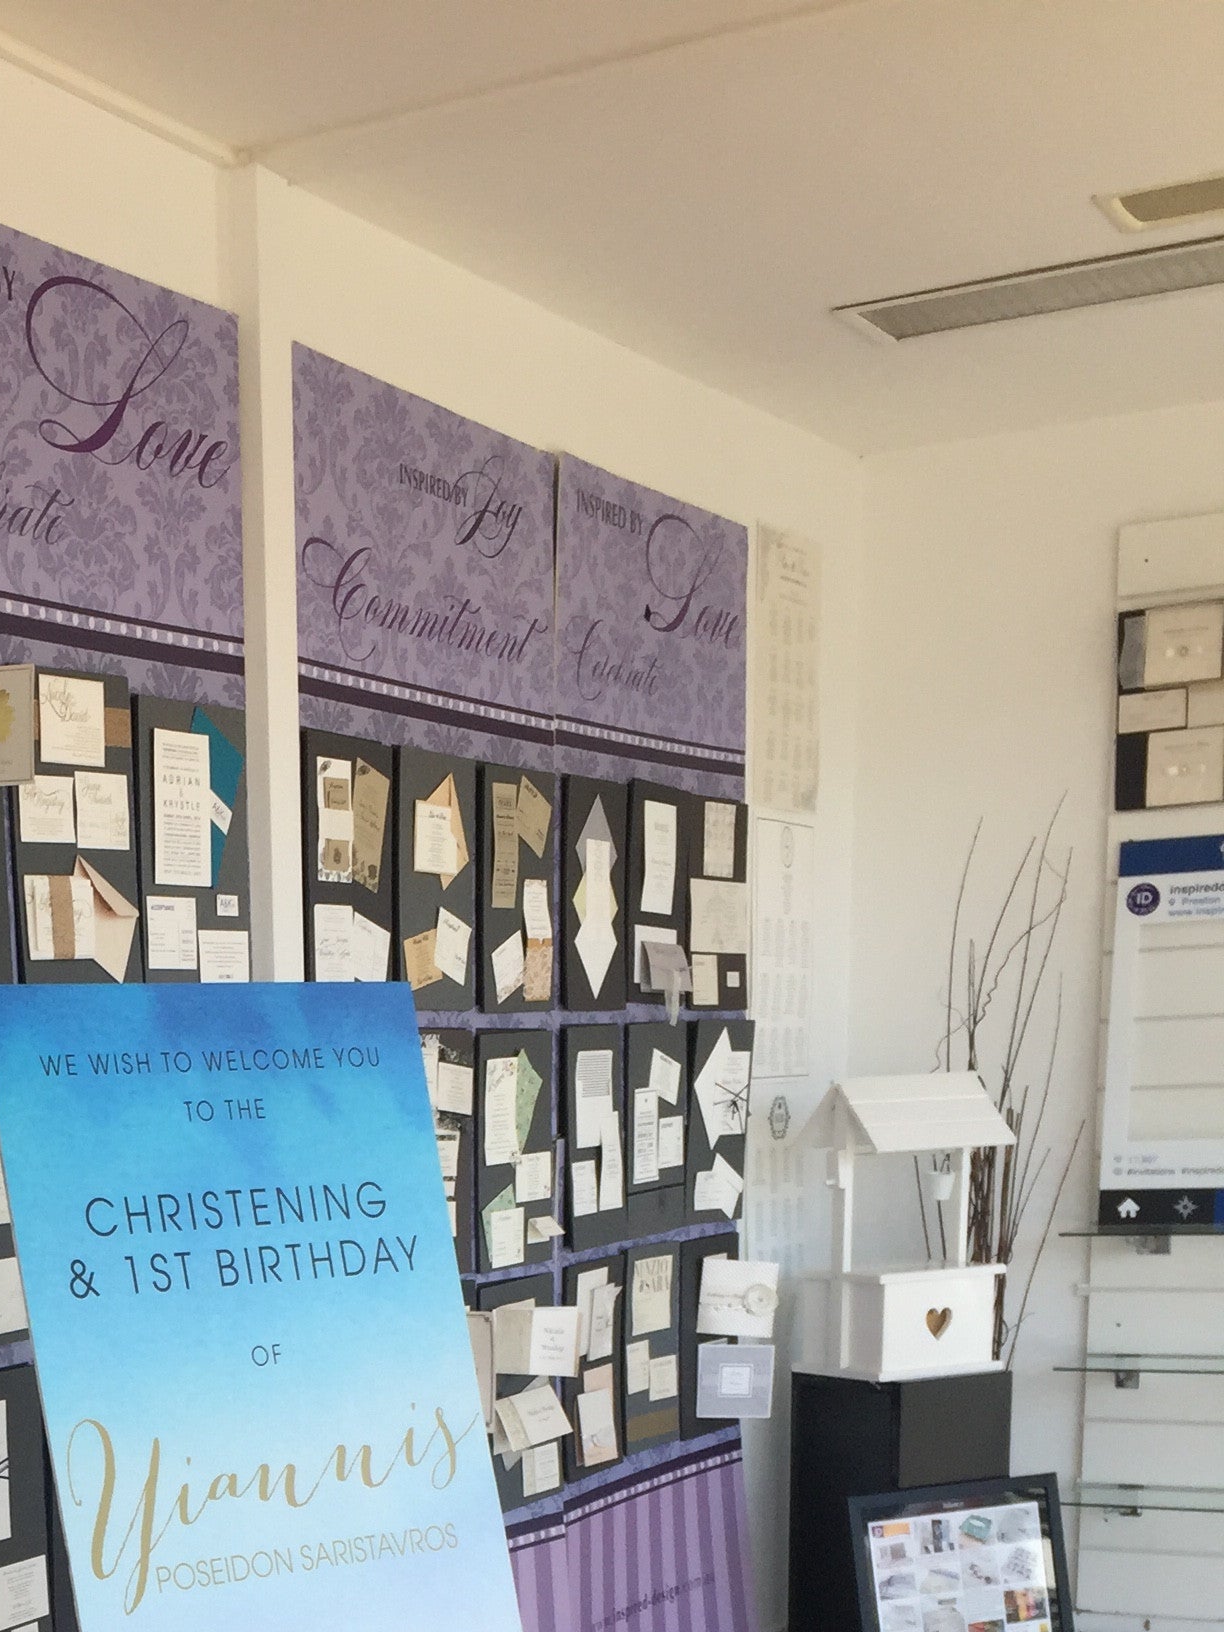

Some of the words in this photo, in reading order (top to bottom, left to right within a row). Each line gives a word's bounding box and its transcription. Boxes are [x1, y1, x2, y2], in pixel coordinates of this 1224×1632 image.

[25, 275, 232, 488] Love
[399, 463, 450, 500] INSPIRED
[454, 486, 468, 507] BY
[576, 488, 627, 531] INSPIRED
[631, 512, 645, 536] BY
[302, 537, 548, 662] Commitment
[39, 1053, 79, 1078] WE
[87, 1050, 152, 1077] WISH
[160, 1050, 192, 1074] TO
[202, 1046, 326, 1073] WELCOME
[332, 1045, 381, 1069] YOU
[183, 1099, 216, 1123] TO
[225, 1097, 267, 1122] THE
[84, 1180, 387, 1238] CHRISTENING
[68, 1258, 101, 1300] &
[124, 1252, 192, 1295] 1ST
[215, 1233, 419, 1289] BIRTHDAY
[250, 1343, 282, 1368] OF
[66, 1402, 479, 1615] Yiannis
[155, 1547, 294, 1594] POSEIDON
[300, 1522, 459, 1572] SARISTAVROS
